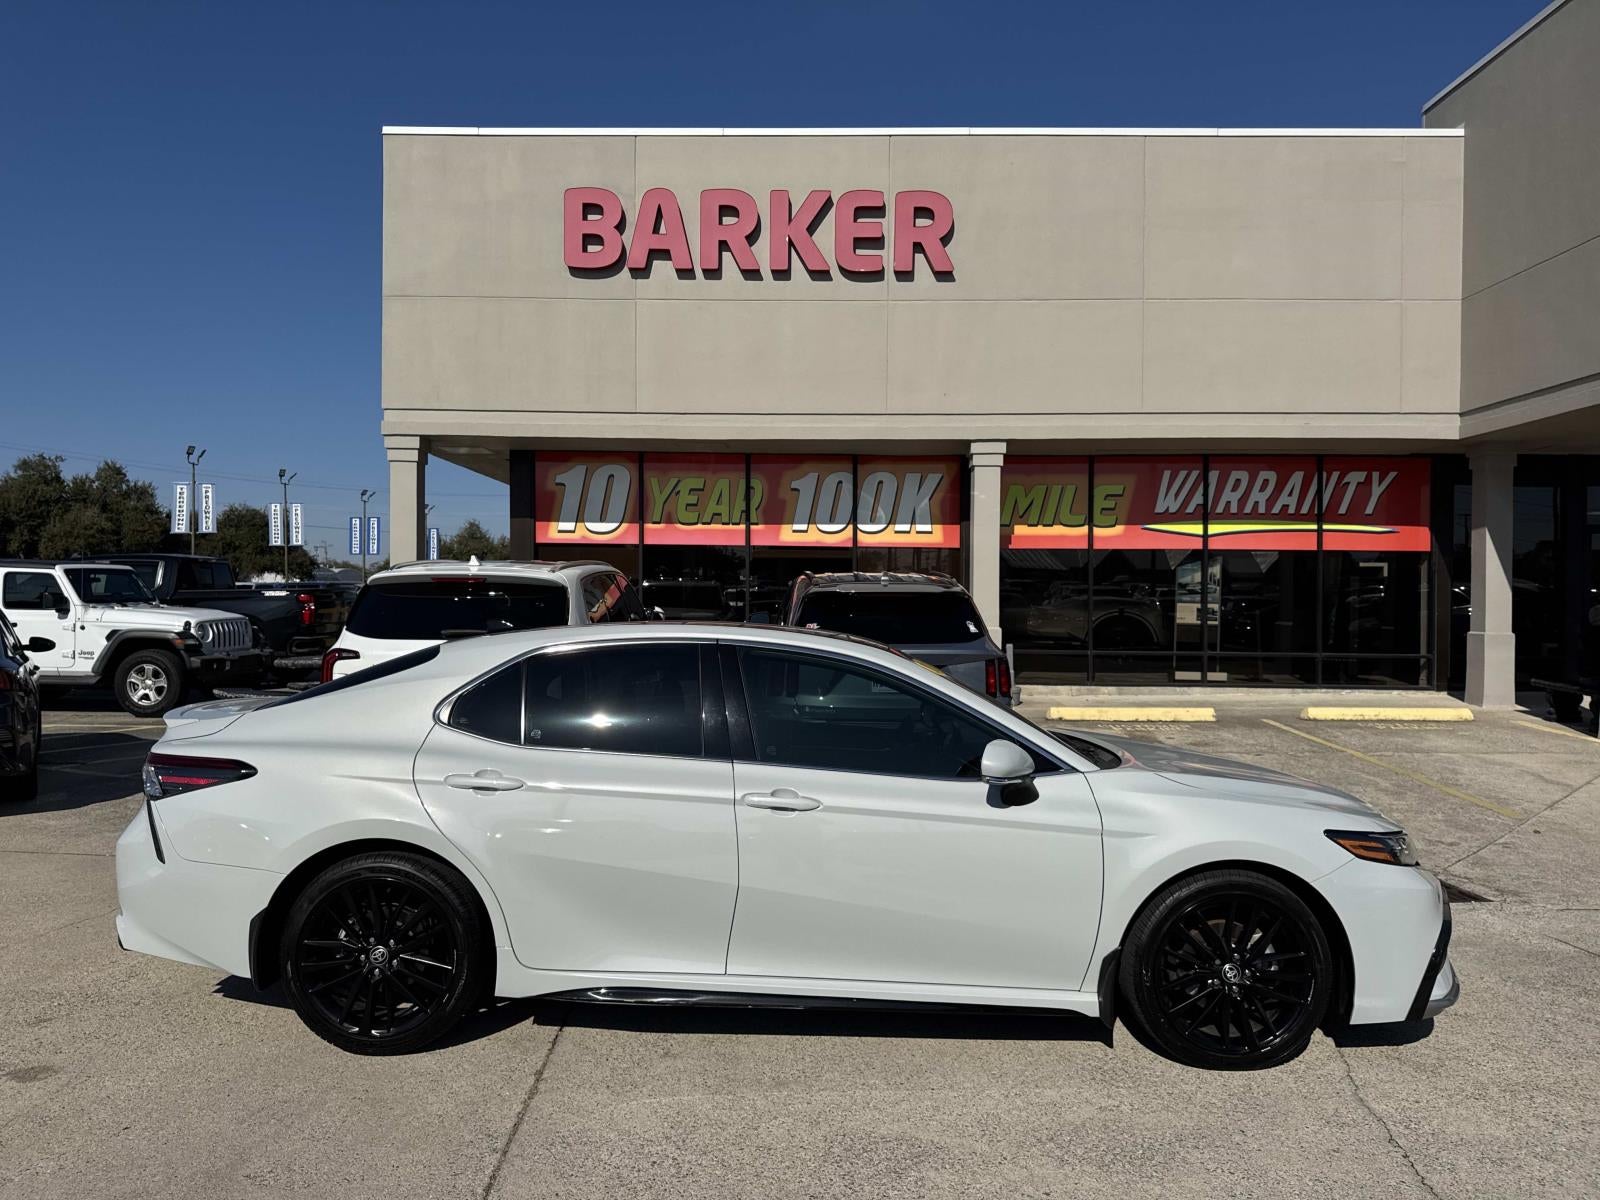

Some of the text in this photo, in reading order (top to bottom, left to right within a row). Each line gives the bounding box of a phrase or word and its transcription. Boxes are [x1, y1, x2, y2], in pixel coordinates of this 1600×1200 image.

[564, 187, 955, 279] BARKER
[554, 464, 1399, 534] 10 YEAR 100K MILE WARRANTY
